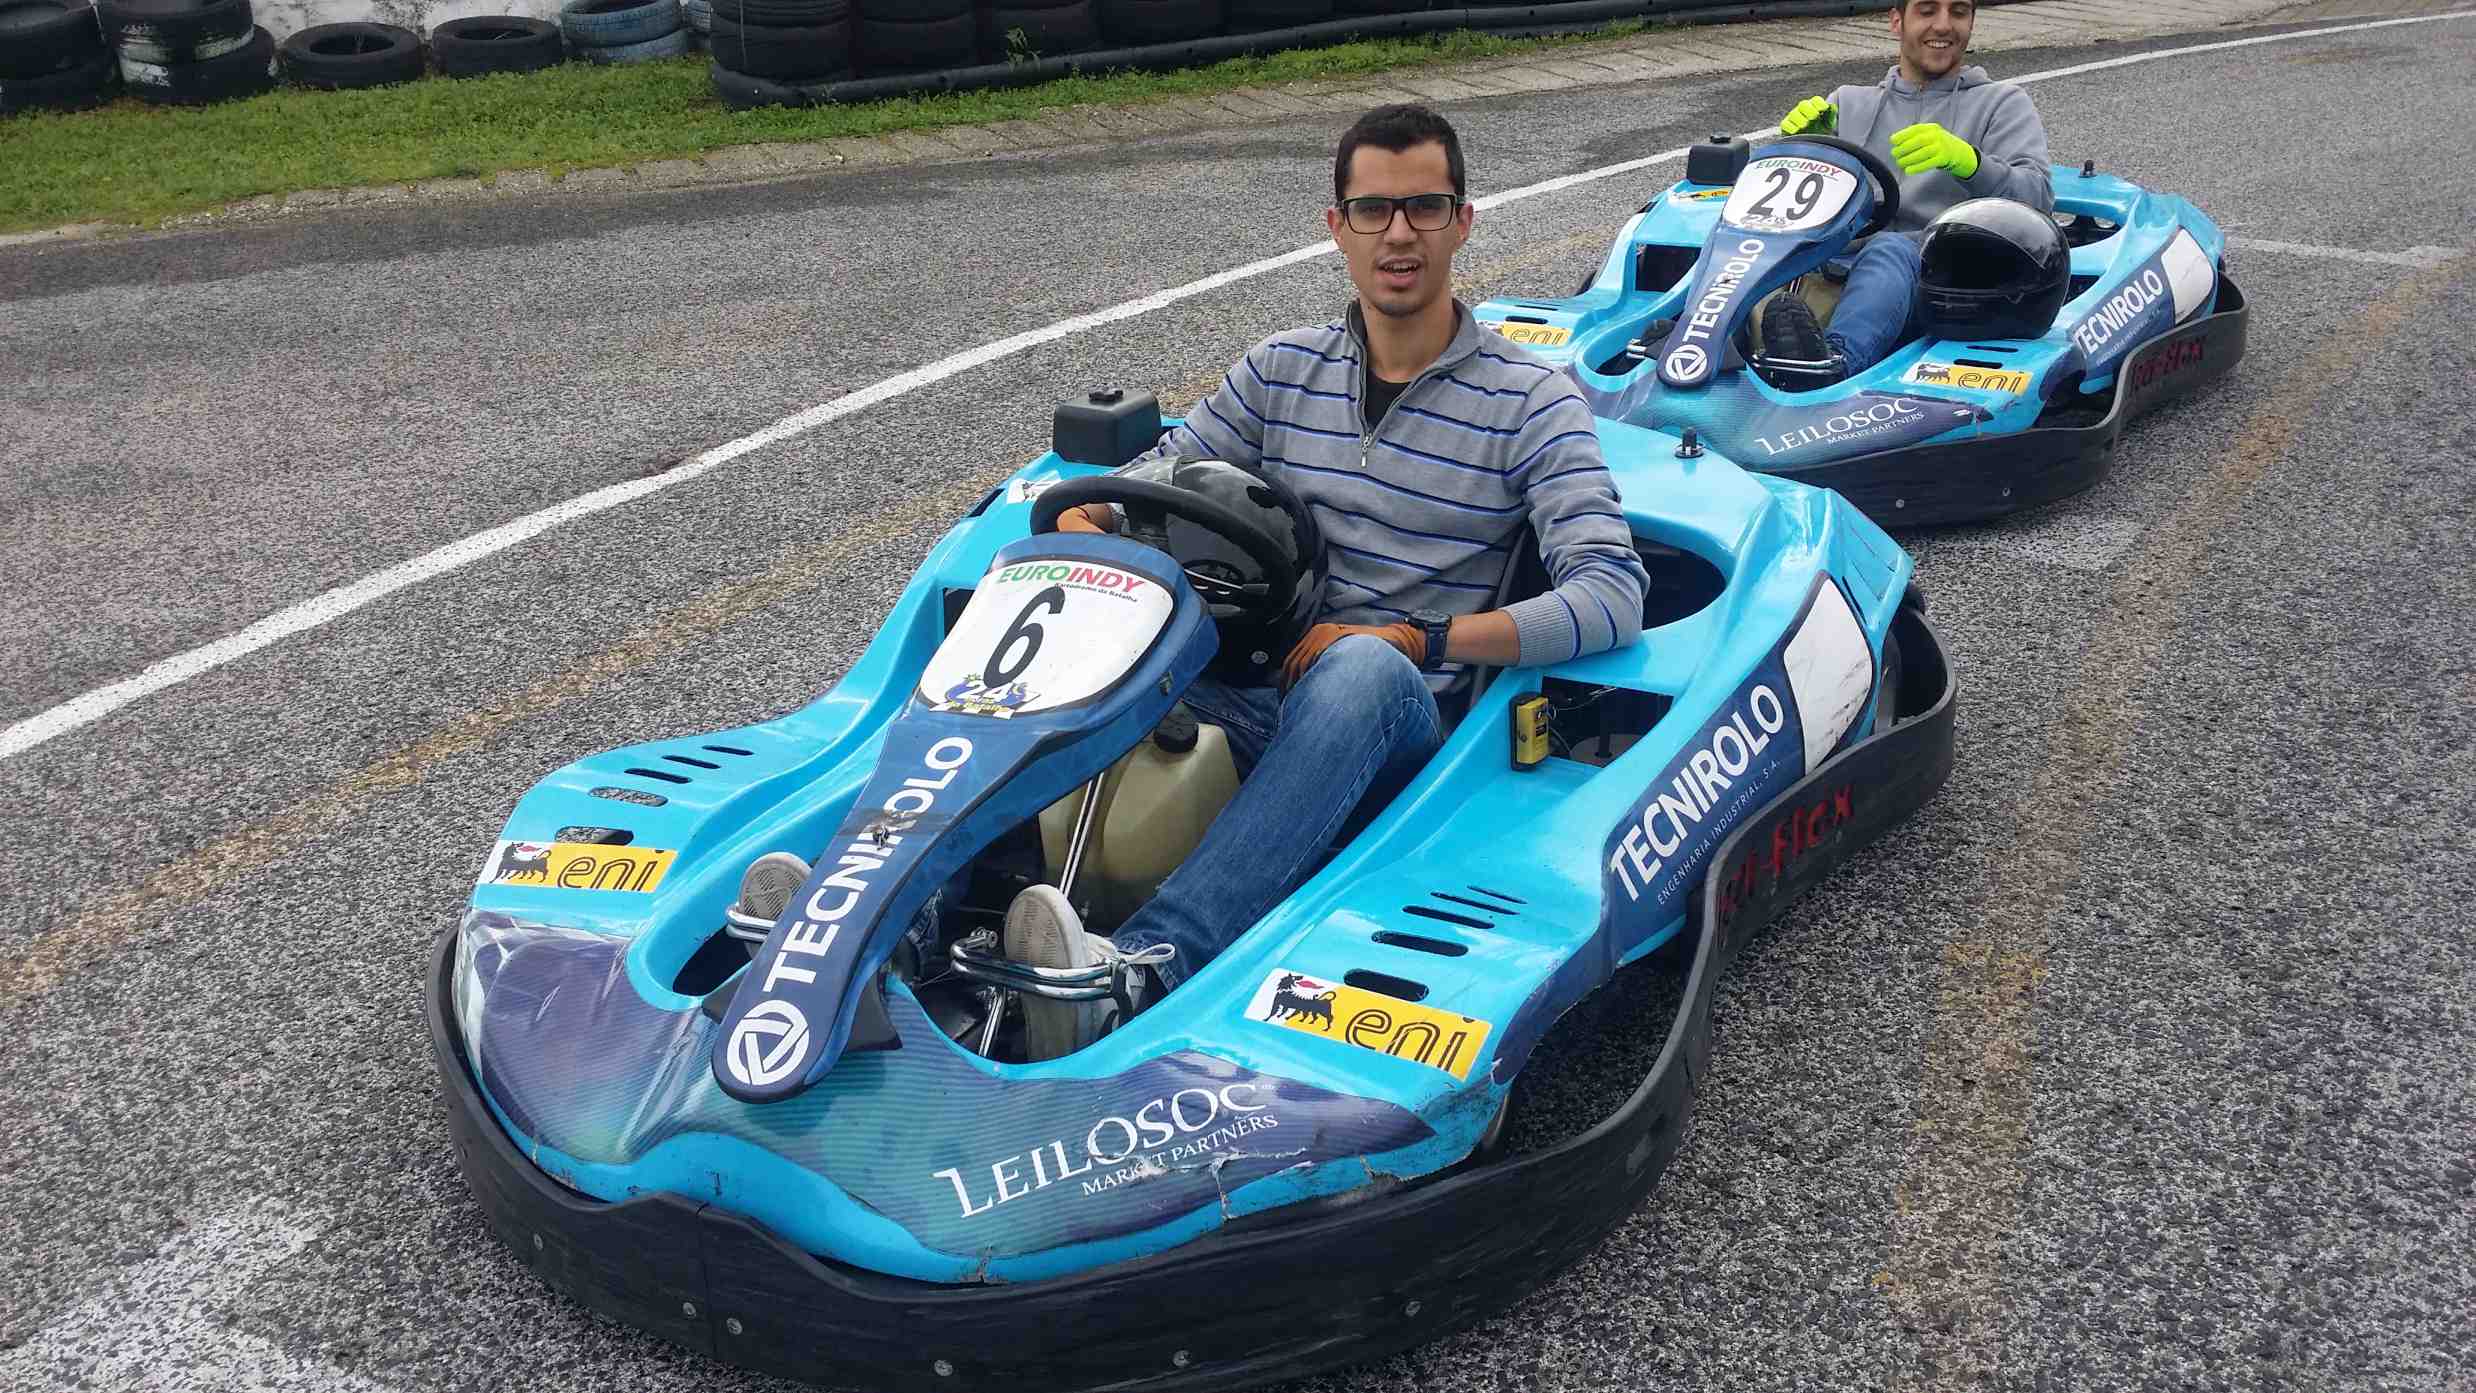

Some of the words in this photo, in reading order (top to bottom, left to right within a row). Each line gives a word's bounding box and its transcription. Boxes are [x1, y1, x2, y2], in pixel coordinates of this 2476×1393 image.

[1748, 168, 1824, 220] 29
[1755, 159, 1842, 177] EUROINDY
[1682, 239, 1765, 342] TECNIROLO
[2073, 270, 2163, 360] TECNIROLO
[1511, 328, 1566, 345] eni
[1957, 370, 2025, 393] eni
[1754, 397, 1920, 456] LEILOSOC
[1827, 429, 1870, 445] MARKET
[1871, 412, 1925, 433] PARTNERS
[997, 564, 1144, 593] EUROINDY
[983, 586, 1065, 688] 6
[1609, 684, 1783, 902] TECNIROLO
[557, 849, 665, 891] eni
[1657, 838, 1711, 905] ENGENHARIA
[1345, 1007, 1476, 1070] eni
[932, 1081, 1269, 1219] LEILOSOC
[1081, 1152, 1166, 1196] MARKT
[1171, 1113, 1279, 1162] PARTNERS
